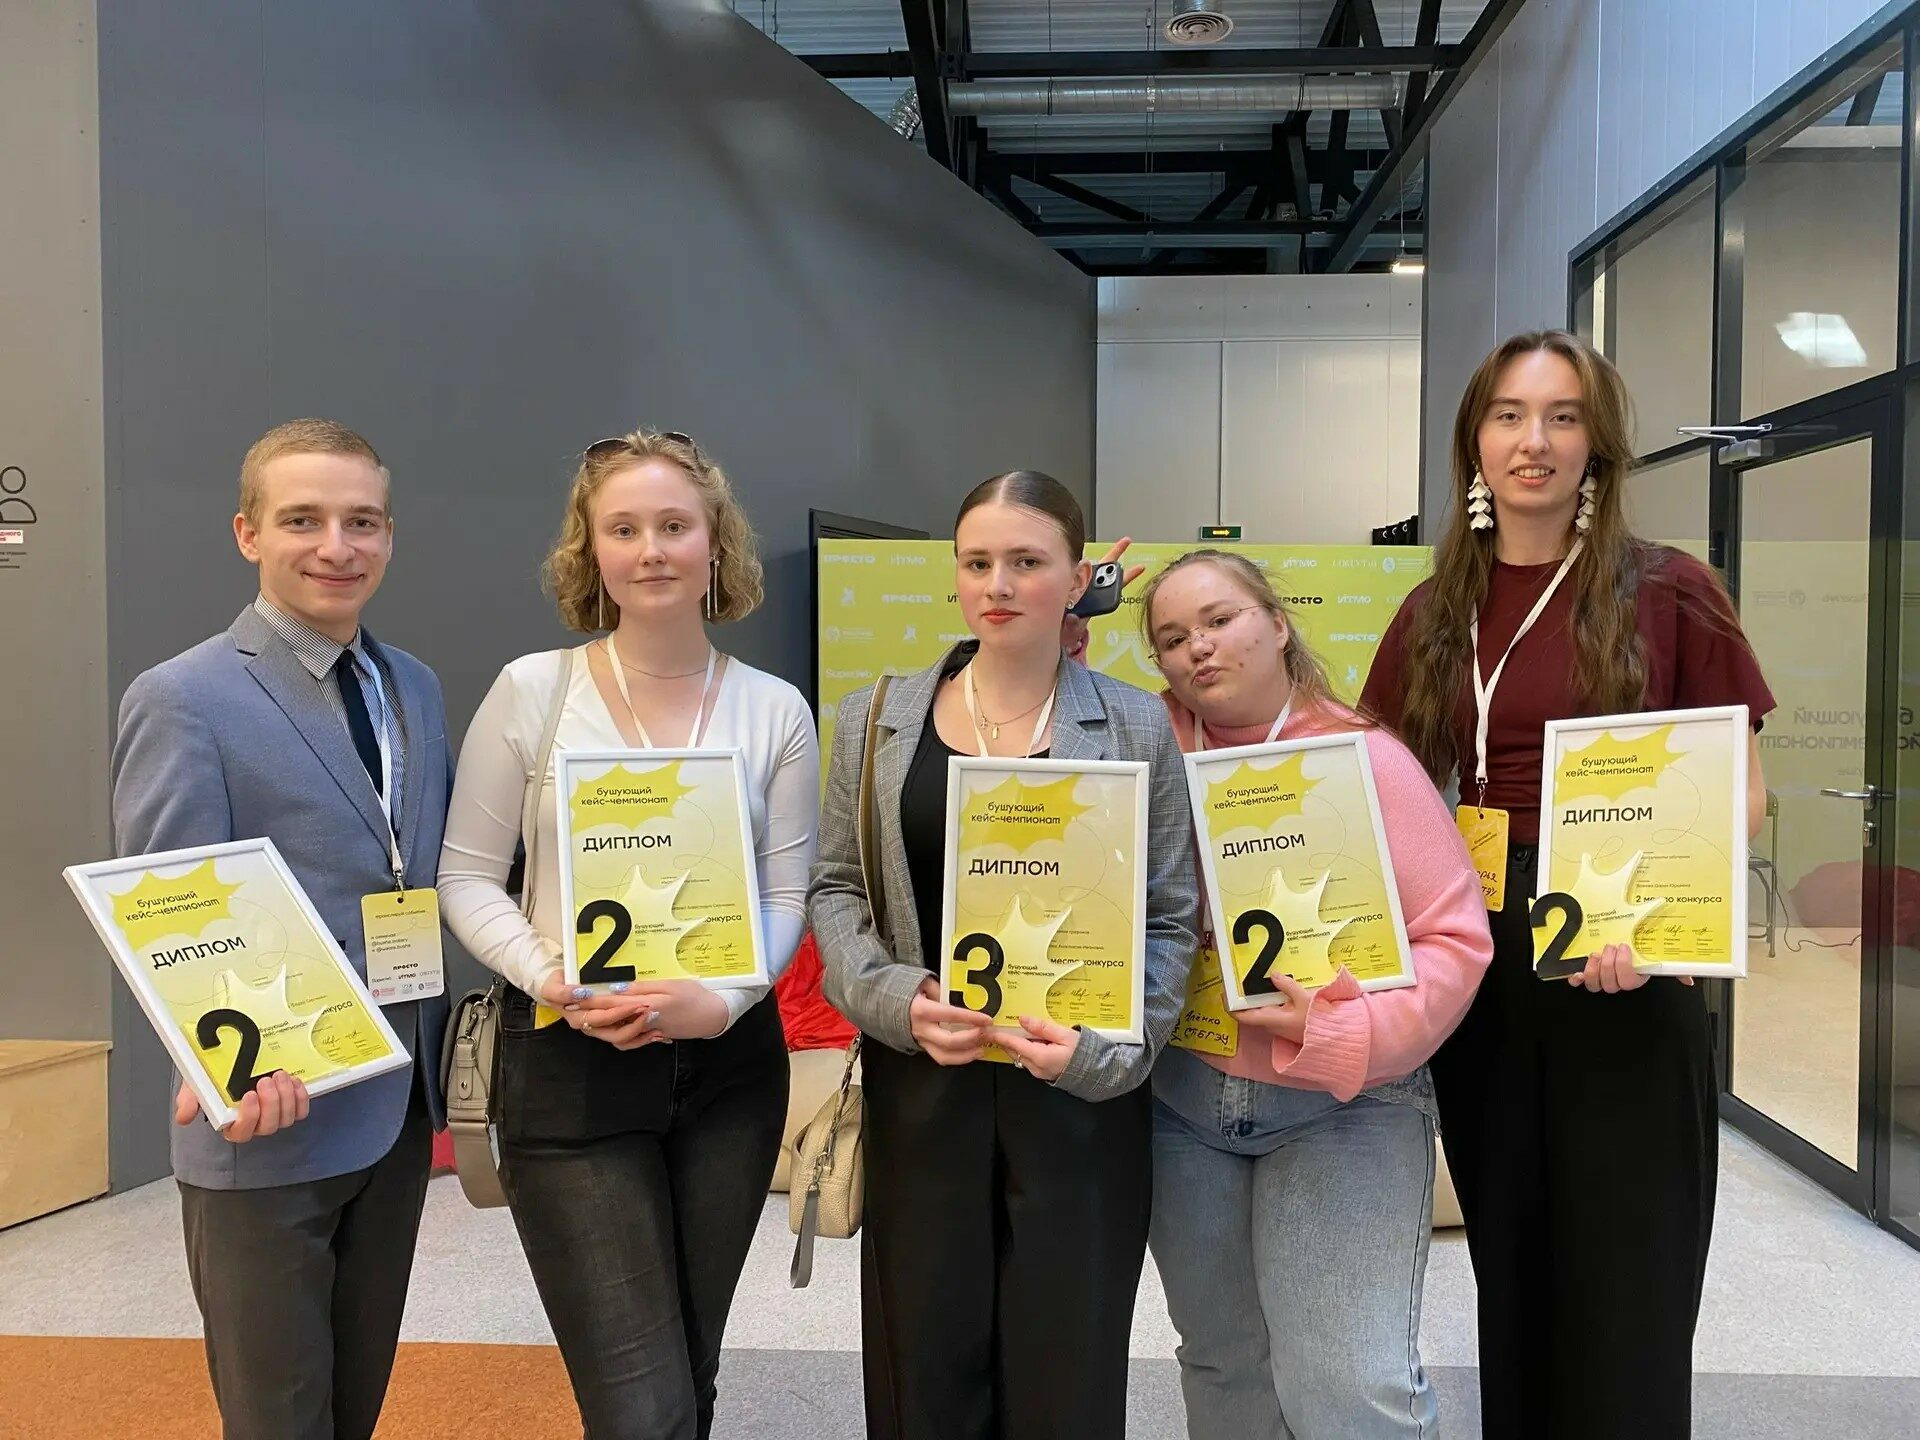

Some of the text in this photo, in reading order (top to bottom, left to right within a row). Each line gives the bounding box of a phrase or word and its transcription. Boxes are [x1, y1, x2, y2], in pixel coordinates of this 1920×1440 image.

[1279, 596, 1323, 605] РОСТО
[1581, 755, 1638, 769] бушующий
[1565, 765, 1654, 778] кейс-чемпионат
[597, 786, 652, 797] бушующий
[1227, 783, 1280, 798] бушующий
[581, 796, 669, 806] кейс-чемпионат
[988, 801, 1045, 814] бушующий
[1213, 792, 1296, 810] кейс-чемпионат
[971, 813, 1061, 825] кейс-чемпионат
[1562, 806, 1653, 826] ДИПЛОМ
[582, 834, 672, 852] ДИПЛОМ
[1221, 833, 1306, 859] ДИПЛОМ
[968, 858, 1059, 877] ДИПЛОМ
[136, 890, 198, 909] бушующий
[1635, 895, 1642, 903] 2
[1677, 895, 1722, 904] конкурса
[125, 898, 220, 922] кейс-чемпионат
[704, 913, 742, 924] онкурса
[1349, 913, 1383, 924] нкурса
[577, 899, 636, 985] 2
[1530, 892, 1589, 979] 2
[151, 936, 247, 970] ДИПЛОМ
[1233, 909, 1294, 996] 2
[949, 932, 1004, 1018] 3
[321, 1000, 353, 1015] нкурса
[196, 1008, 284, 1103] 2
